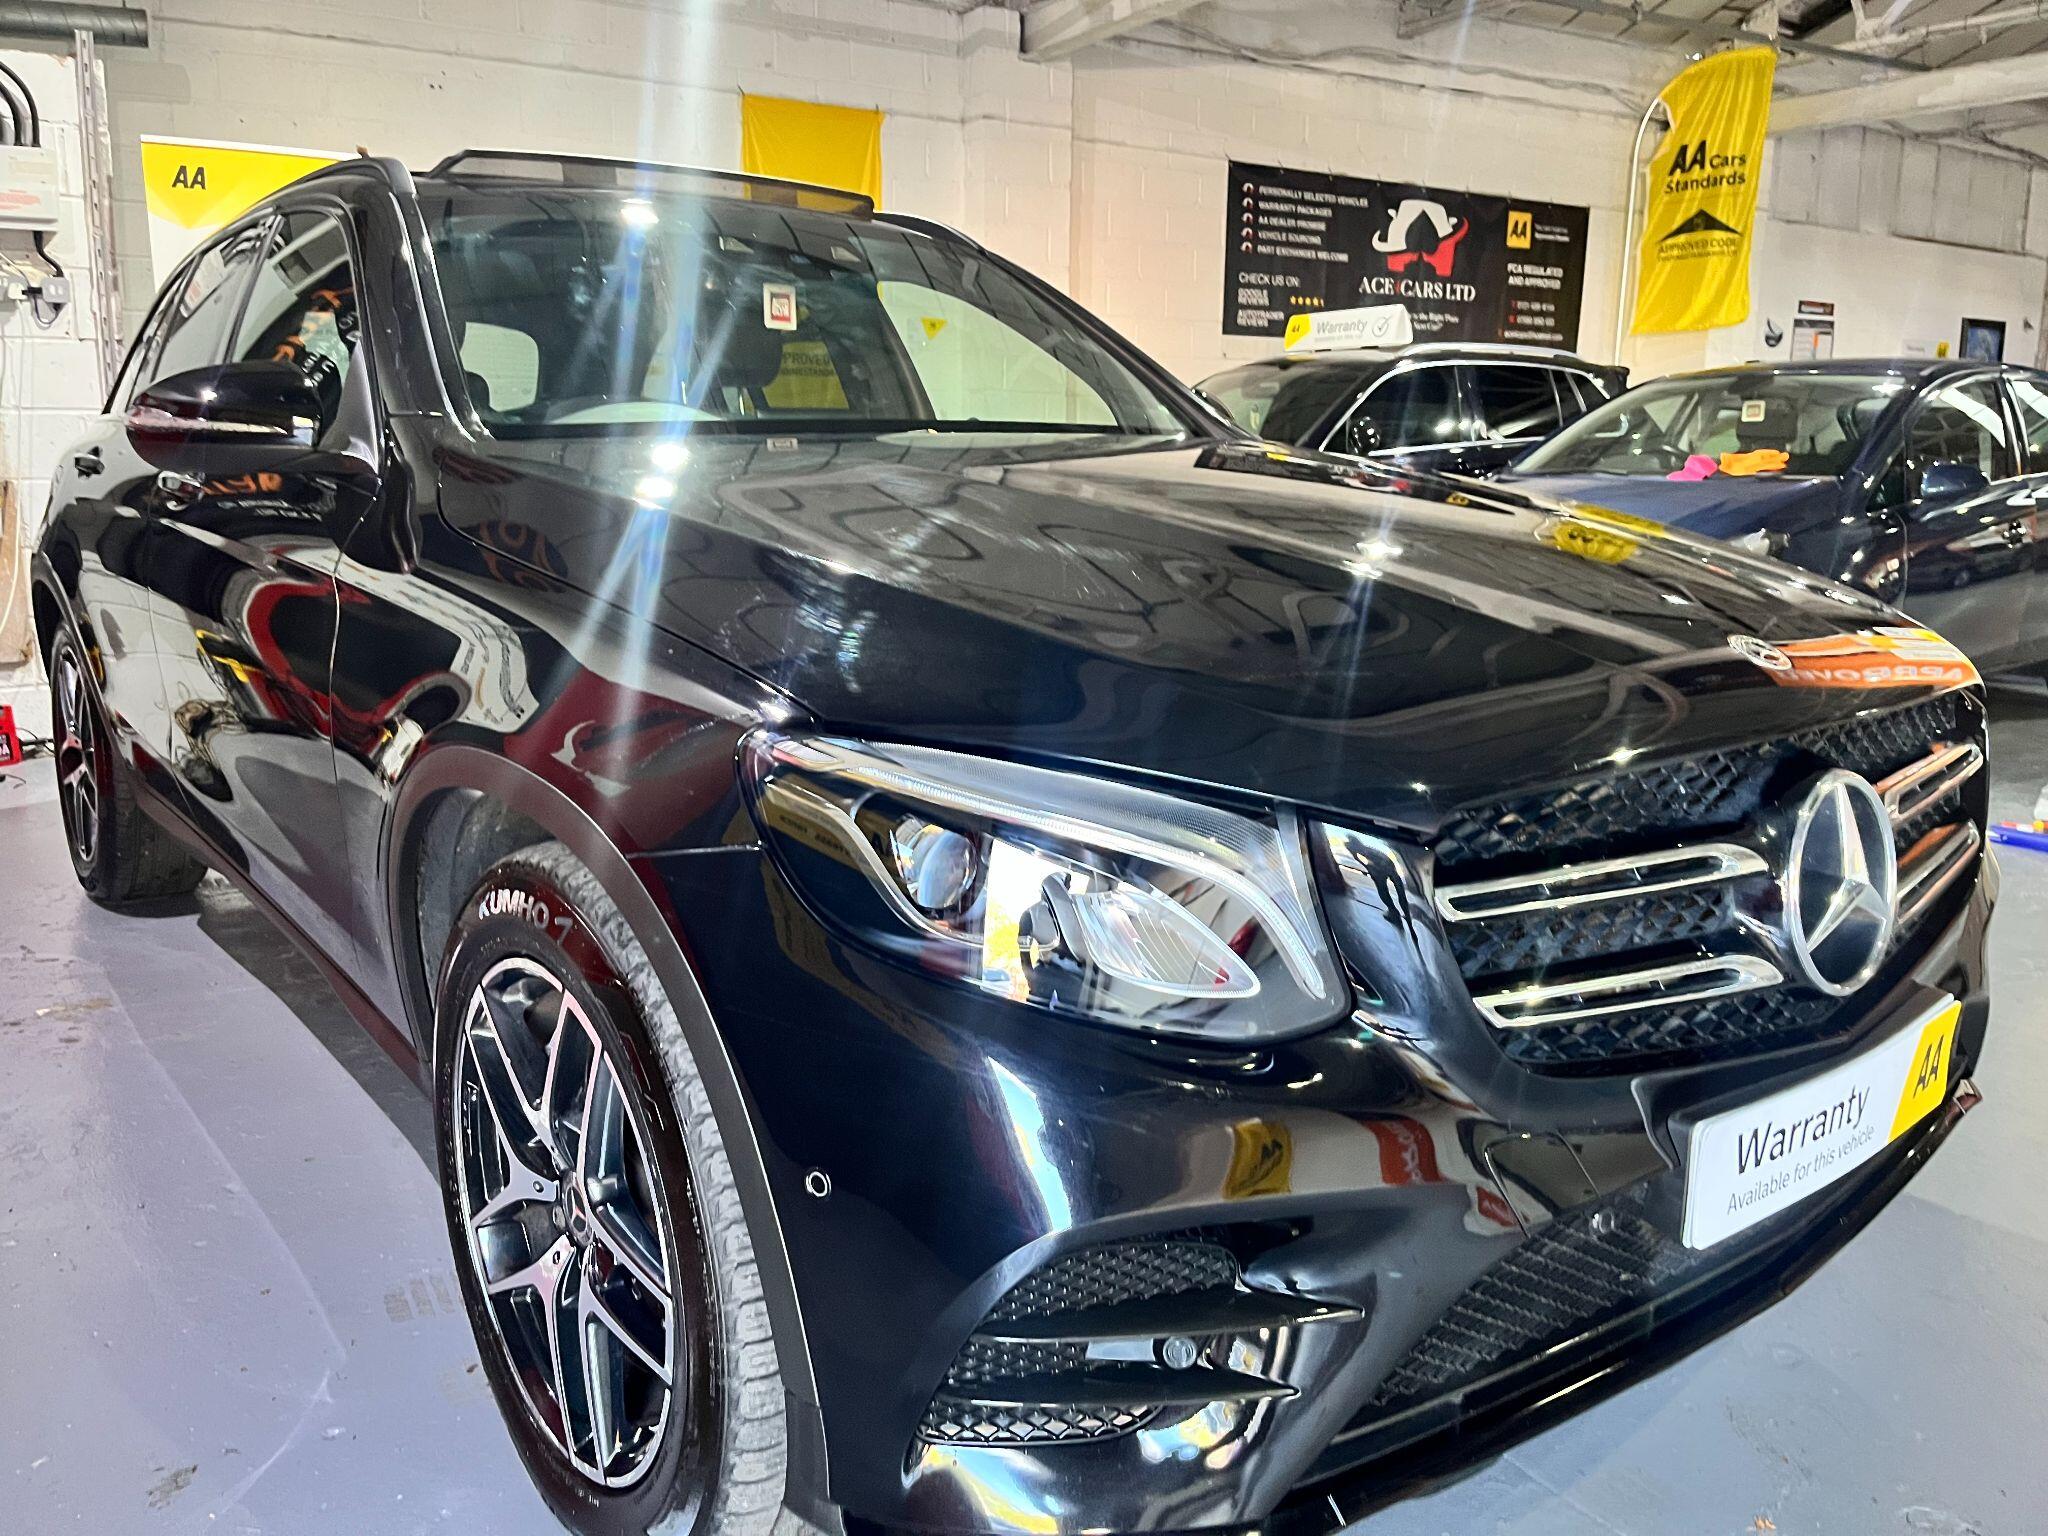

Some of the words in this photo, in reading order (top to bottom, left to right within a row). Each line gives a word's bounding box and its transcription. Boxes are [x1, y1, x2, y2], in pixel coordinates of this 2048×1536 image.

[1668, 140, 1707, 176] AA
[1709, 154, 1747, 169] Cars
[171, 165, 206, 190] AA
[1664, 171, 1746, 194] Standards
[1510, 220, 1527, 238] AA
[1239, 272, 1270, 285] CHECK
[1271, 275, 1284, 286] US
[1400, 279, 1443, 299] CARS
[1446, 283, 1476, 301] LTD
[1317, 319, 1368, 334] Warranty
[478, 888, 549, 930] KUMHO
[1738, 1085, 1871, 1175] Warranty
[1913, 1034, 1944, 1099] AA
[1727, 1168, 1790, 1216] Available
[1793, 1160, 1812, 1184] for
[1814, 1149, 1835, 1173] this
[1838, 1124, 1875, 1159] vehicle
